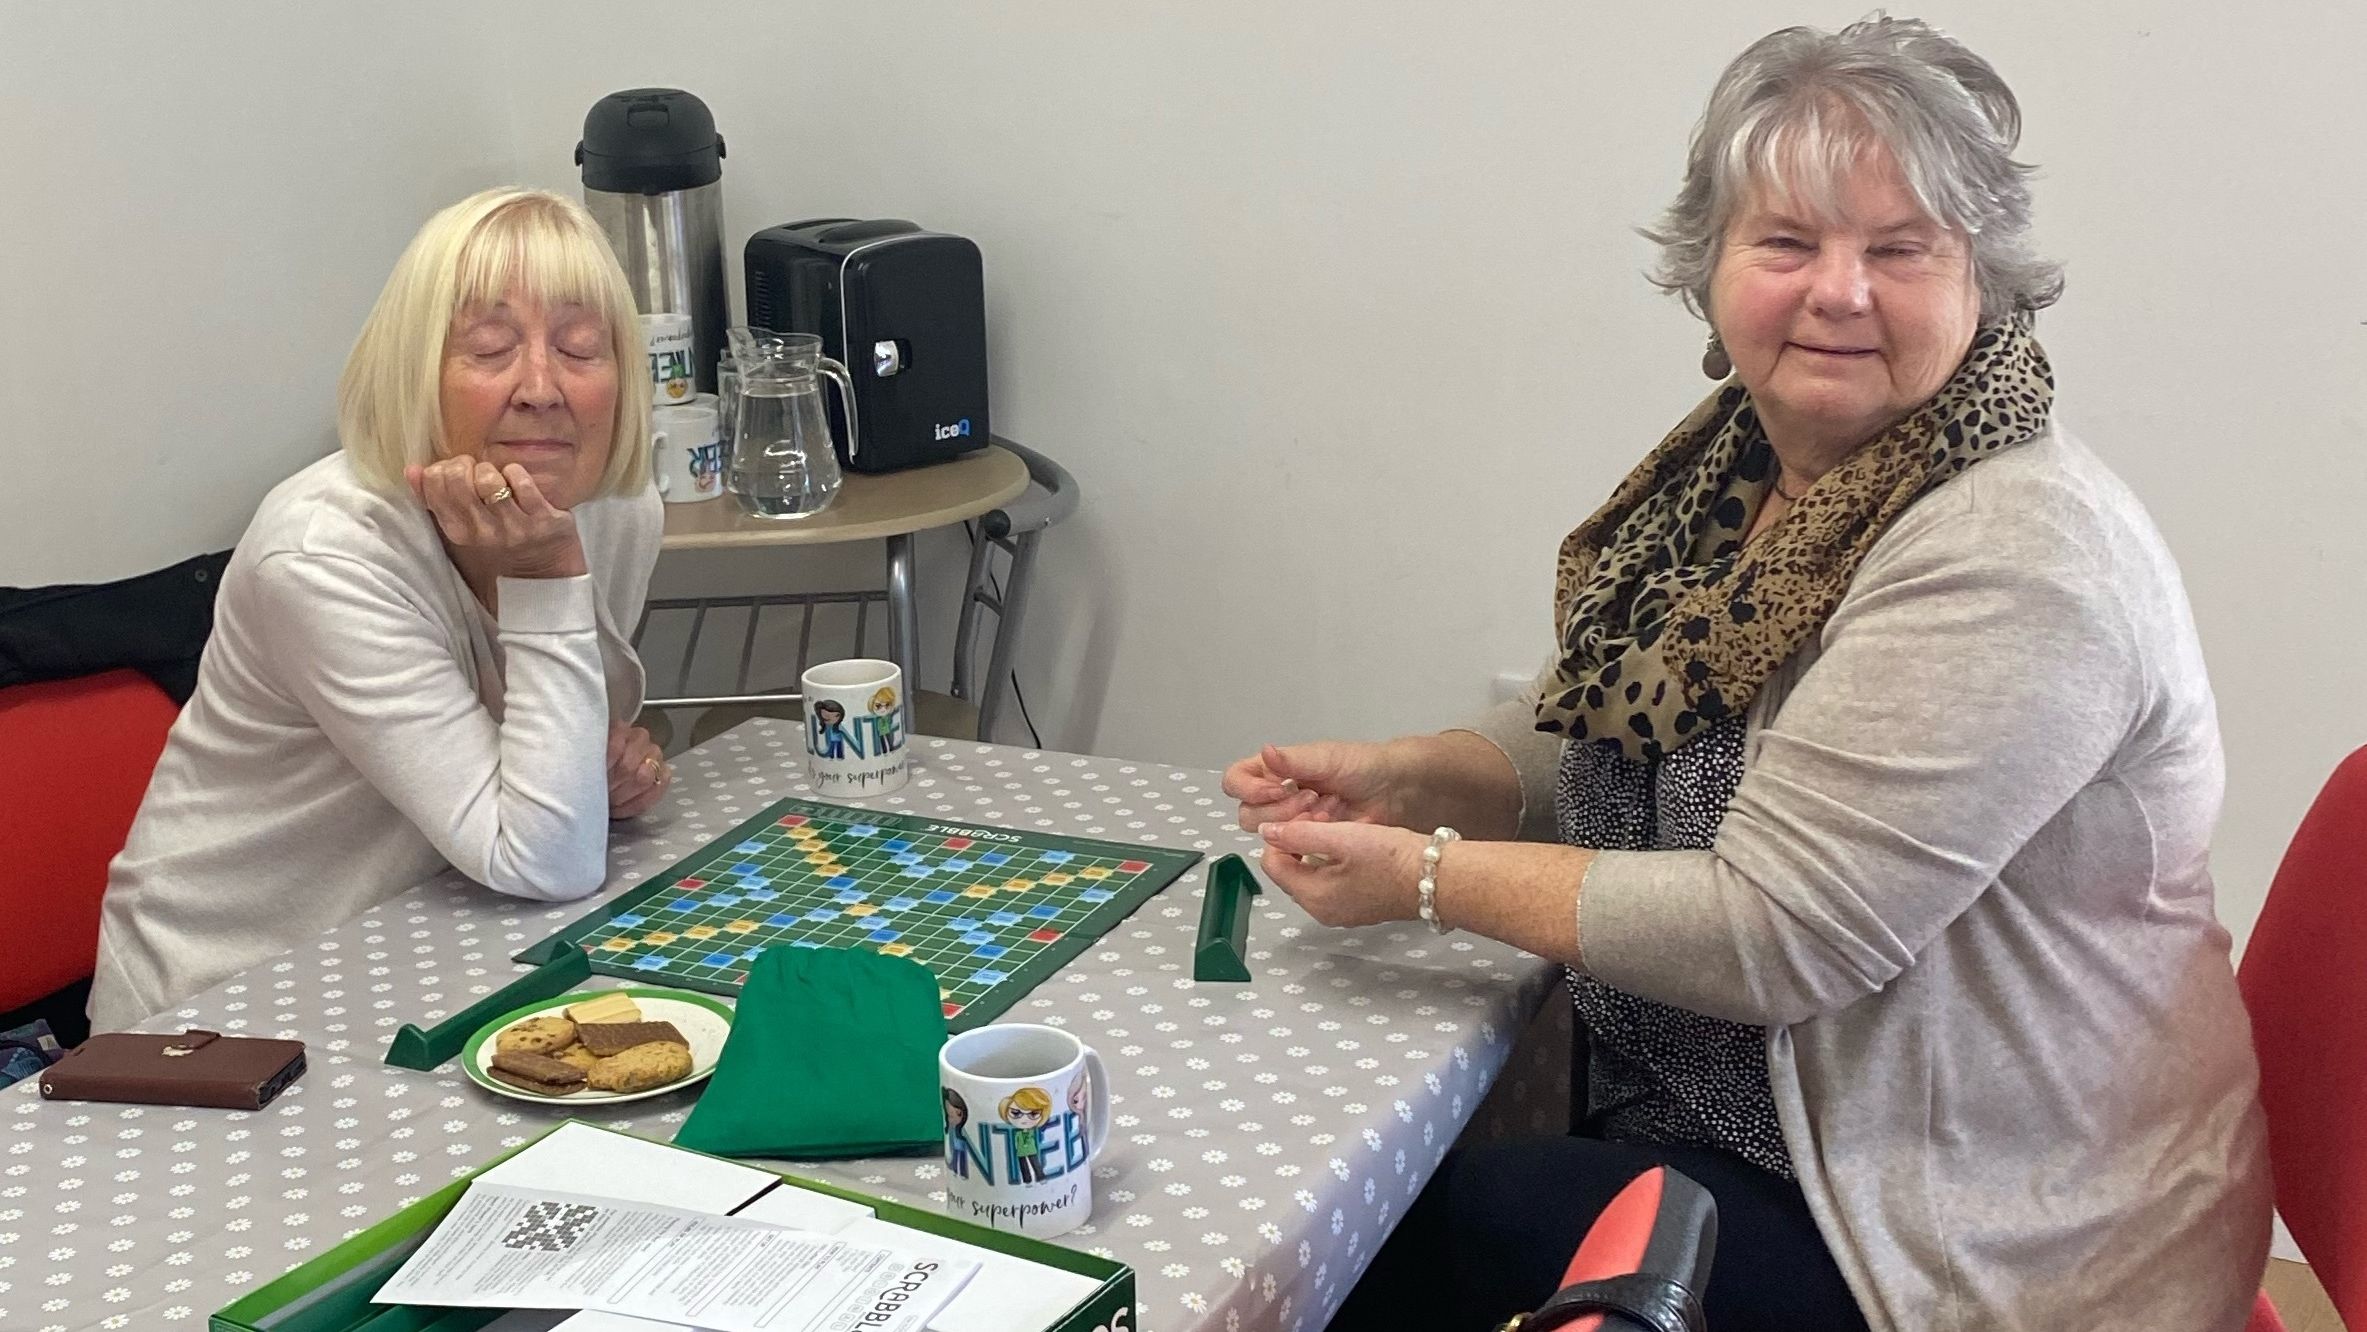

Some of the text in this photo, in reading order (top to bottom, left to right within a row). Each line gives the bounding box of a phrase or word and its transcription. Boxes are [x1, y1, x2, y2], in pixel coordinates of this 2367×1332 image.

[934, 418, 971, 441] iceQ
[924, 823, 1024, 844] SCRABBLE
[971, 1183, 1078, 1229] superpower?
[851, 1261, 939, 1332] SCRABBL
